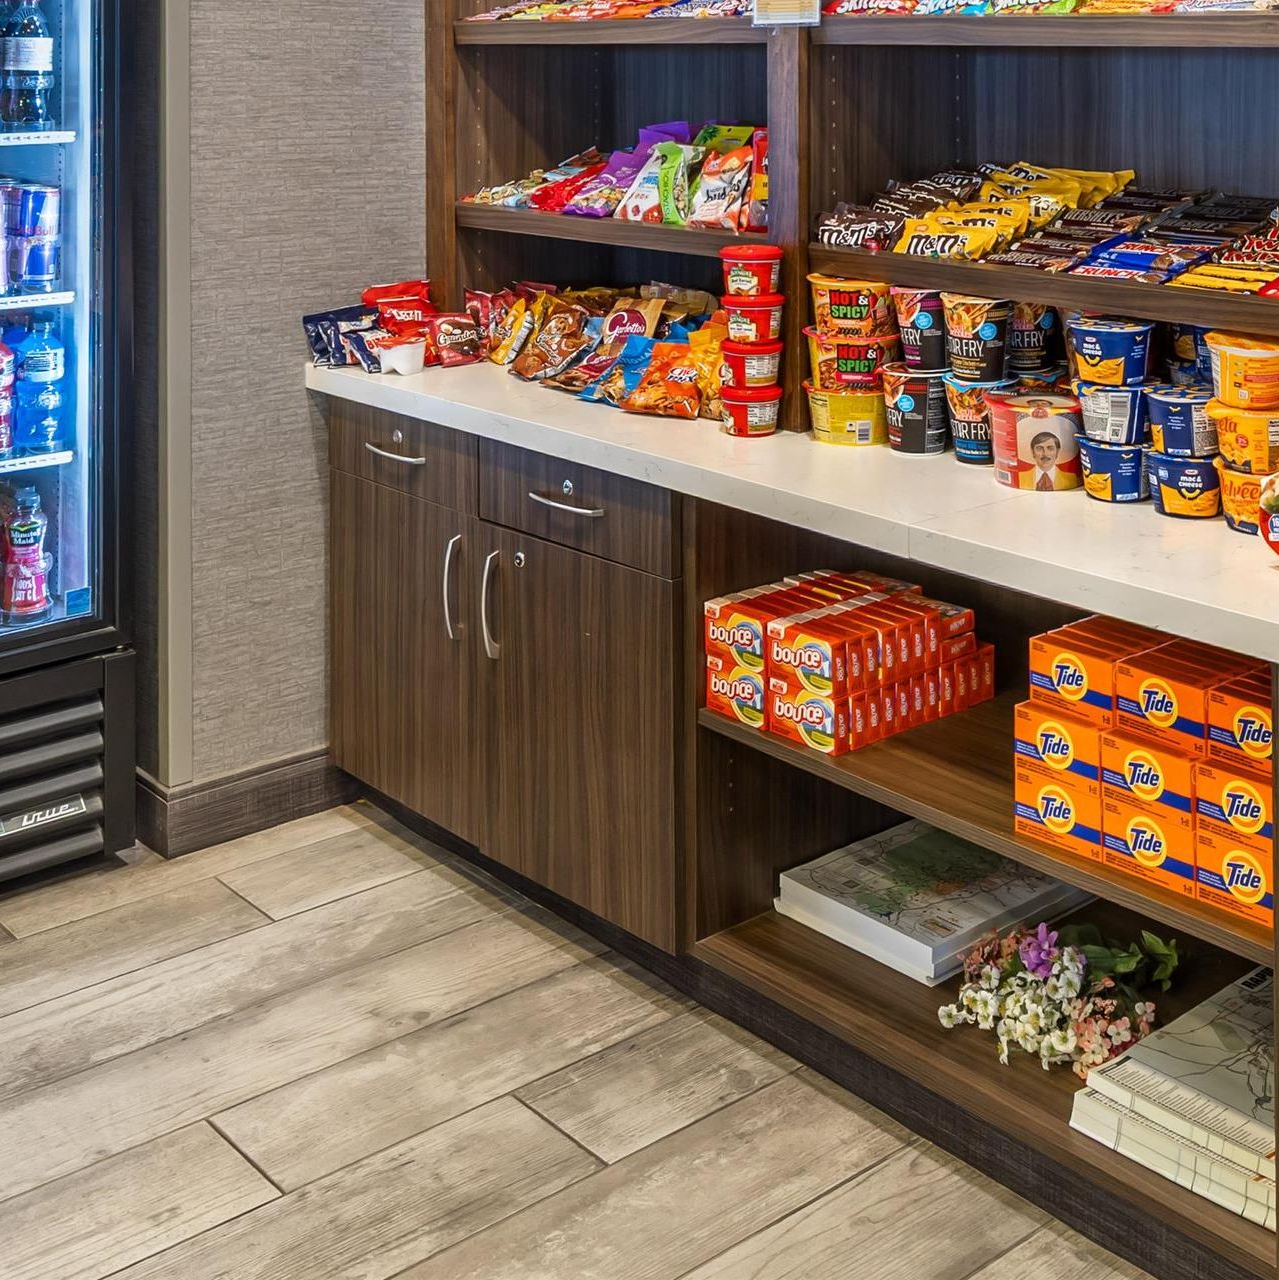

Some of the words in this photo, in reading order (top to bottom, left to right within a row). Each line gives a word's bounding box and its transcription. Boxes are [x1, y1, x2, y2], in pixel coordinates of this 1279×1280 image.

[1071, 266, 1145, 278] CRUNCH
[830, 292, 858, 305] HOT
[830, 304, 868, 319] SPICY
[837, 345, 866, 359] HOT
[838, 357, 874, 372] SPICY
[10, 530, 41, 538] Minute
[13, 536, 34, 544] Maid
[710, 625, 753, 646] bounce
[773, 643, 821, 666] bounce
[1055, 664, 1084, 687] Tide
[711, 674, 753, 698] bounce
[1143, 690, 1173, 713] Tide
[1237, 719, 1272, 743] Tide
[1040, 733, 1070, 755] Tide
